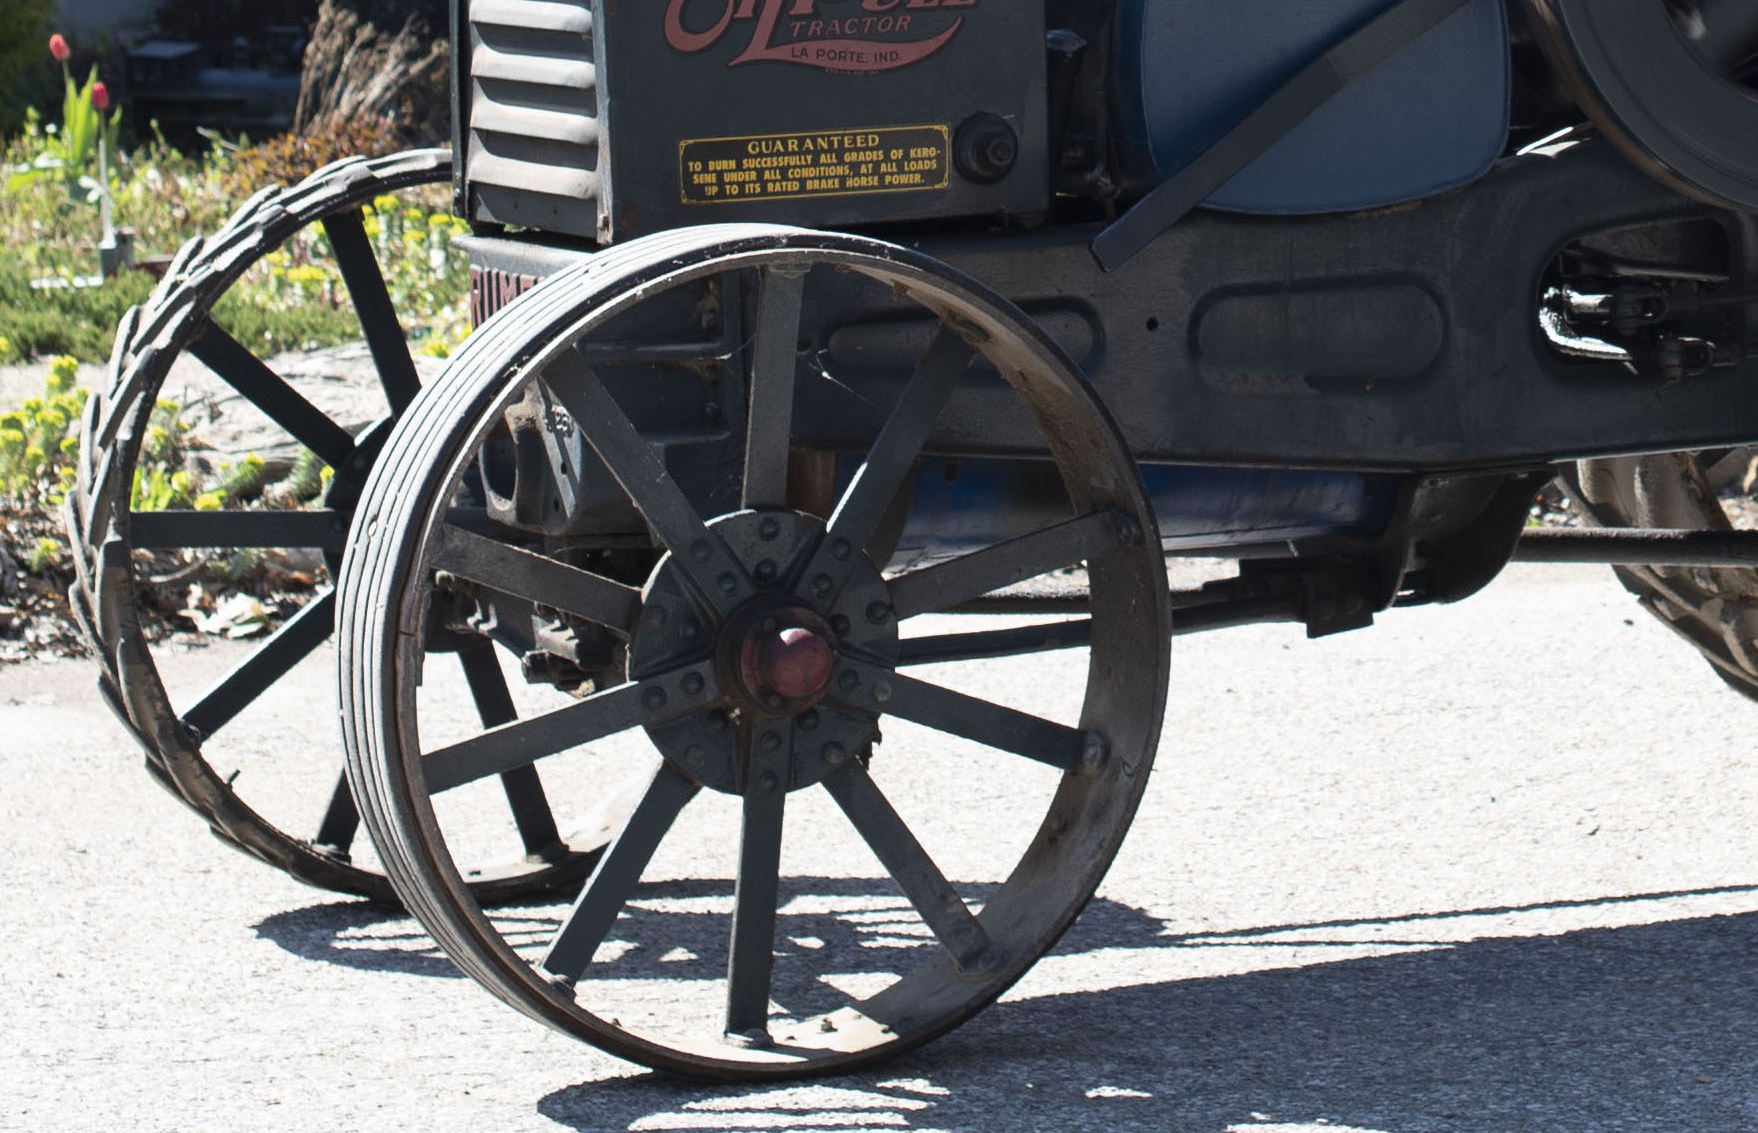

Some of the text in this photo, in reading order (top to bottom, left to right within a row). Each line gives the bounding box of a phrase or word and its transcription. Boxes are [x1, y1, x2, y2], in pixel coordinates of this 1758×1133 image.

[790, 15, 911, 38] TRACTOR
[791, 47, 808, 59] LA
[747, 134, 880, 155] GUARANTEED
[688, 146, 941, 172] TO BURN SUCCESSFULLY ALL GRADES OF KERO-
[692, 159, 937, 184] SENE UNDER ALL CONDITIONS, AT ALL LOADS
[705, 173, 925, 196] UP TO ITS RATED BRAKE HORSE POWER.
